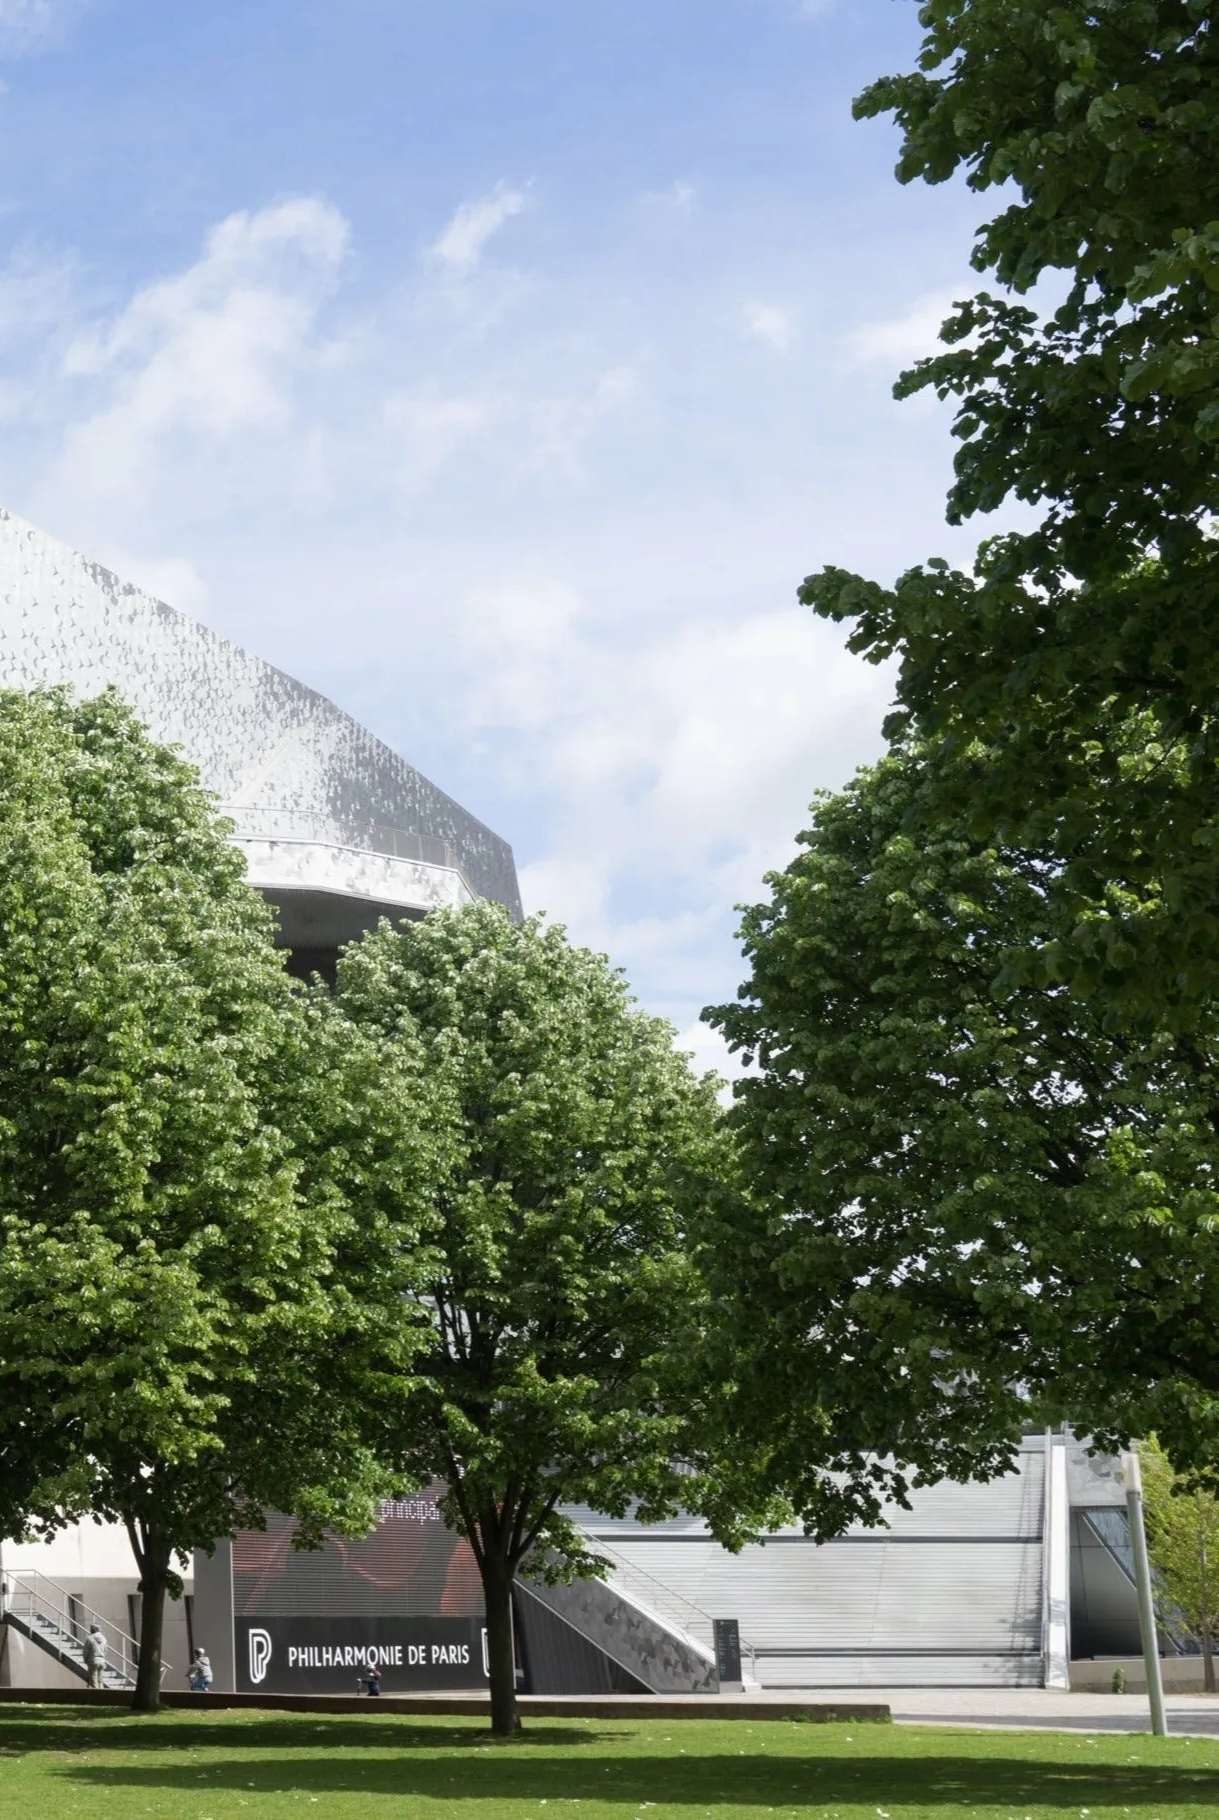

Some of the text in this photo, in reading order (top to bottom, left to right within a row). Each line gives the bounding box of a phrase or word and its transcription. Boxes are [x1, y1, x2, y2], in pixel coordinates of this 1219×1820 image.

[288, 1645, 403, 1667] PHILHARMONIE
[407, 1644, 427, 1665] DE
[431, 1643, 470, 1665] PARIS
